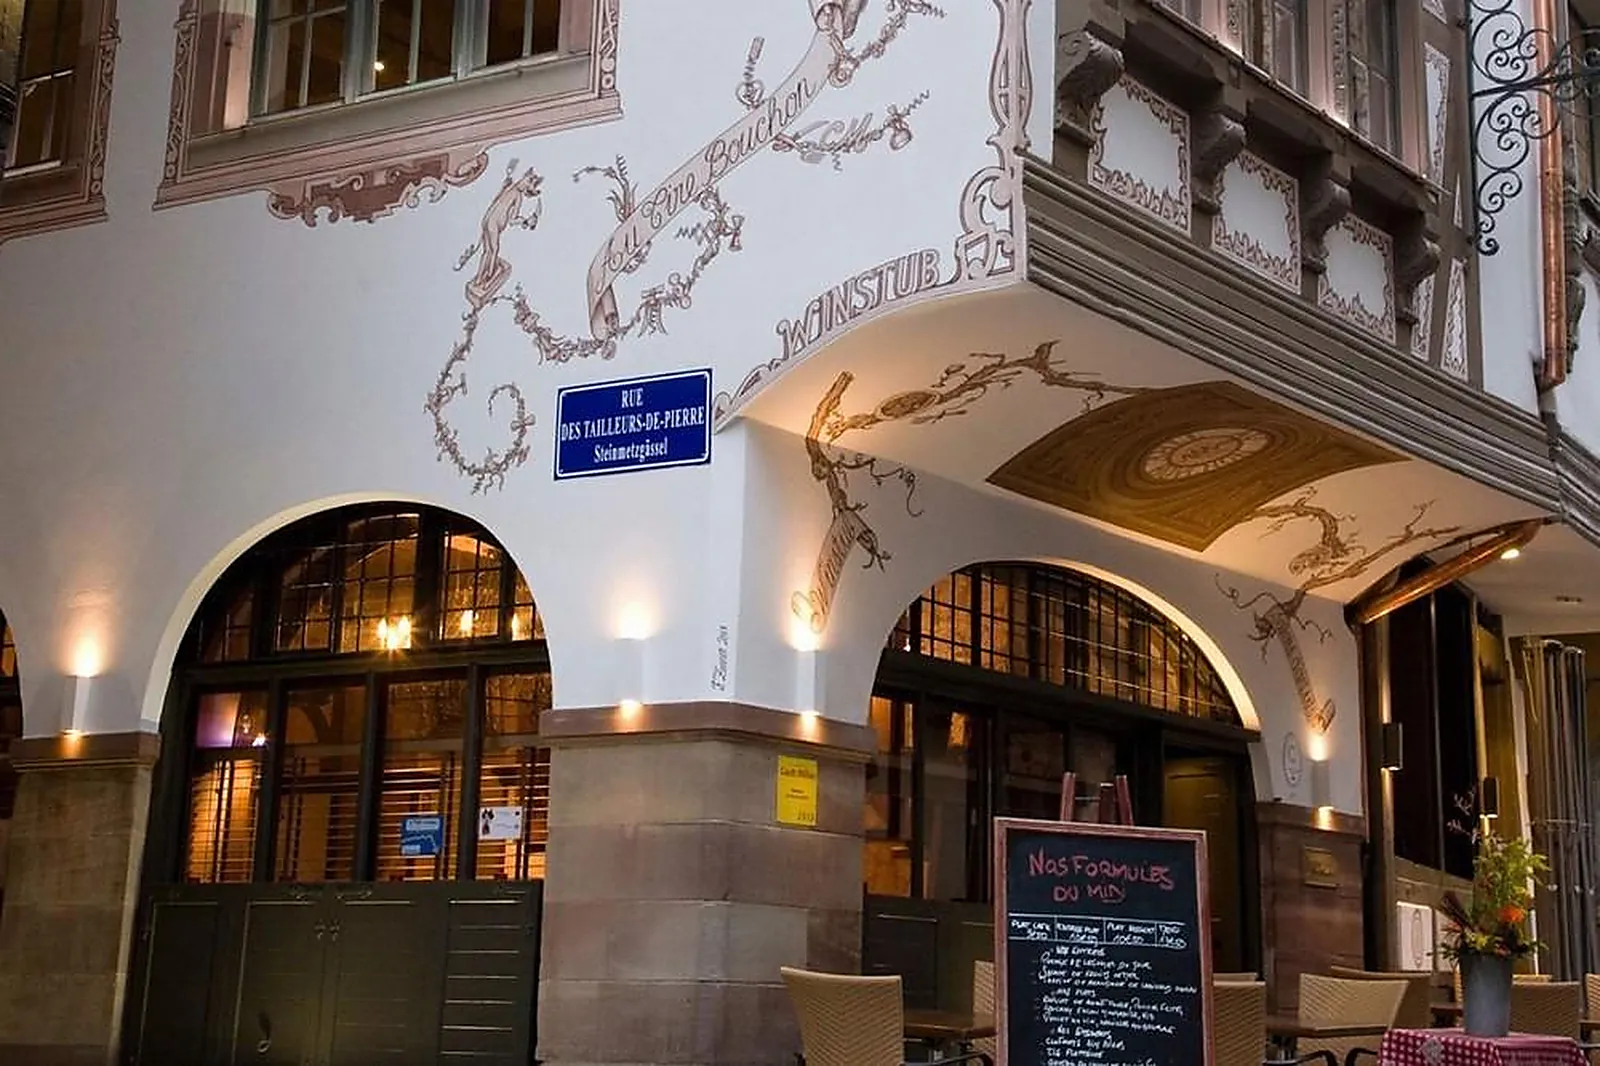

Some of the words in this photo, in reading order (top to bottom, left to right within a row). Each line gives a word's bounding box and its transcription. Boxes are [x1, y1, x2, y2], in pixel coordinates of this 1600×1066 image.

[703, 77, 817, 188] Bouchon
[776, 249, 940, 361] WINSTUB
[621, 388, 644, 408] RUE
[561, 422, 582, 441] DES
[583, 406, 705, 439] TAILLEURS-DE-PIERRE
[593, 437, 668, 463] Steinmetzgässel
[1053, 885, 1078, 901] DU
